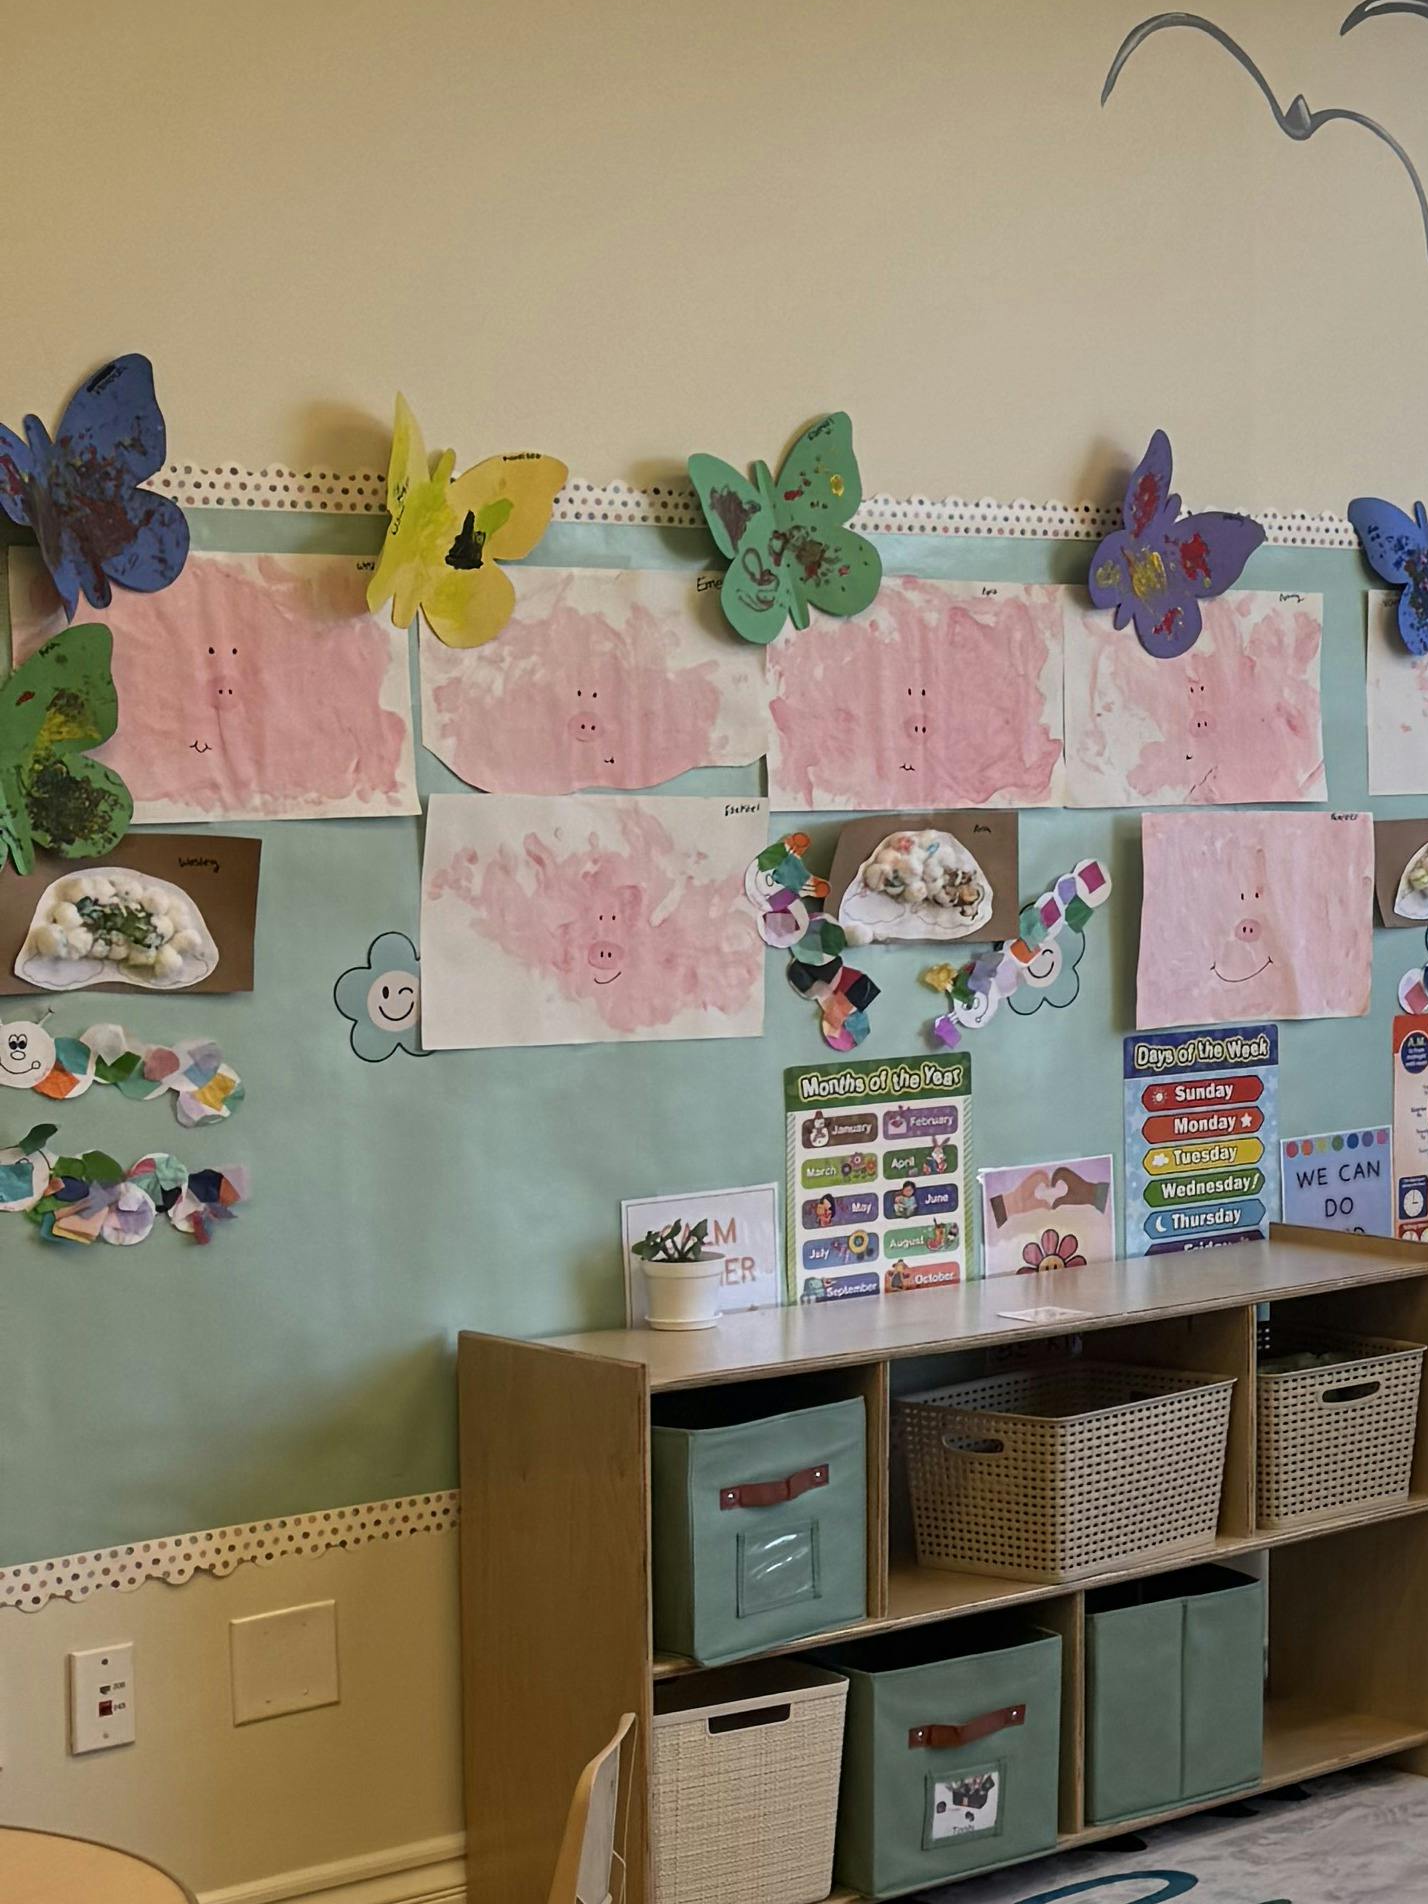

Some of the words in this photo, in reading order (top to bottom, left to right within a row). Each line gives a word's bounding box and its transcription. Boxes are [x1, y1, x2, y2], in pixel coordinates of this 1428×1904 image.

[1136, 1044, 1174, 1070] Days
[1177, 1041, 1196, 1065] of
[1197, 1038, 1225, 1061] the
[1225, 1035, 1269, 1062] Week
[800, 1072, 866, 1100] Months
[868, 1067, 889, 1093] of
[890, 1066, 922, 1093] the
[922, 1063, 962, 1088] Year
[1174, 1082, 1234, 1103] Sunday
[830, 1122, 873, 1136] January
[908, 1114, 954, 1128] February
[1173, 1113, 1237, 1135] Monday
[805, 1165, 837, 1177] March
[890, 1155, 916, 1170] April
[1173, 1146, 1238, 1166] Tuesday
[1296, 1167, 1328, 1189] WE
[1338, 1159, 1381, 1183] CAN
[1161, 1175, 1252, 1199] Wednesday
[851, 1201, 872, 1215] May
[924, 1192, 950, 1205] June
[1324, 1196, 1354, 1218] DO
[1171, 1208, 1242, 1231] Thursday
[808, 1248, 830, 1261] July
[888, 1235, 925, 1249] August
[825, 1281, 878, 1298] September
[914, 1271, 955, 1285] October
